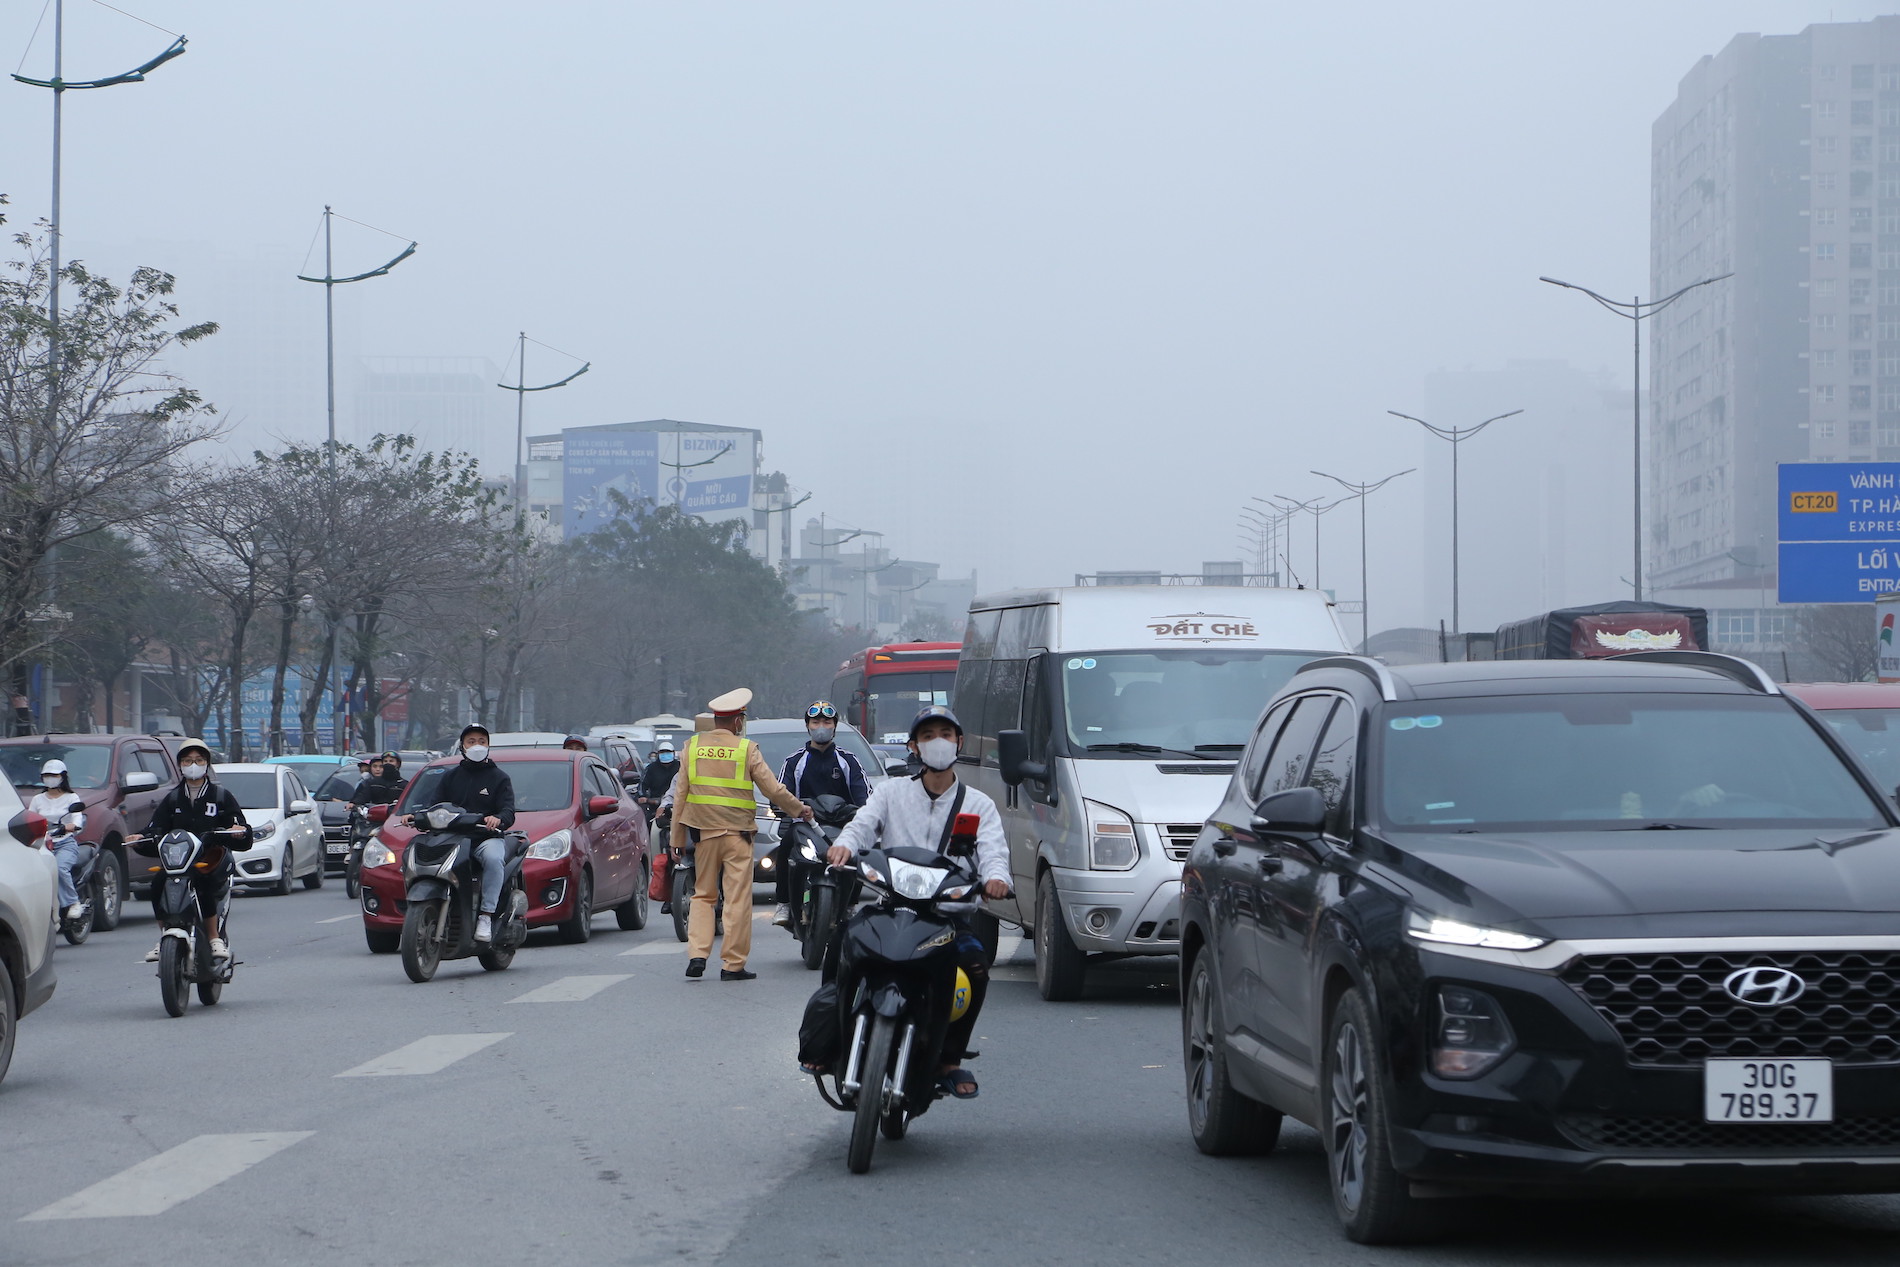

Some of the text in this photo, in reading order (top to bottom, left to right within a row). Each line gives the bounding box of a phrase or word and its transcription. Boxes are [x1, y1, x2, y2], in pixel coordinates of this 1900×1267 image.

[684, 439, 736, 451] BIZMAN
[1850, 470, 1894, 489] VÀNH
[705, 483, 722, 494] MỜI
[687, 492, 737, 507] QUẢNG CÁO
[1793, 495, 1834, 509] CT.20
[1858, 548, 1888, 569] LỐI
[1146, 619, 1260, 636] ĐẤT CHÈ
[204, 802, 217, 817] D
[1742, 1063, 1796, 1089] 30G
[1720, 1092, 1819, 1119] 789.37
